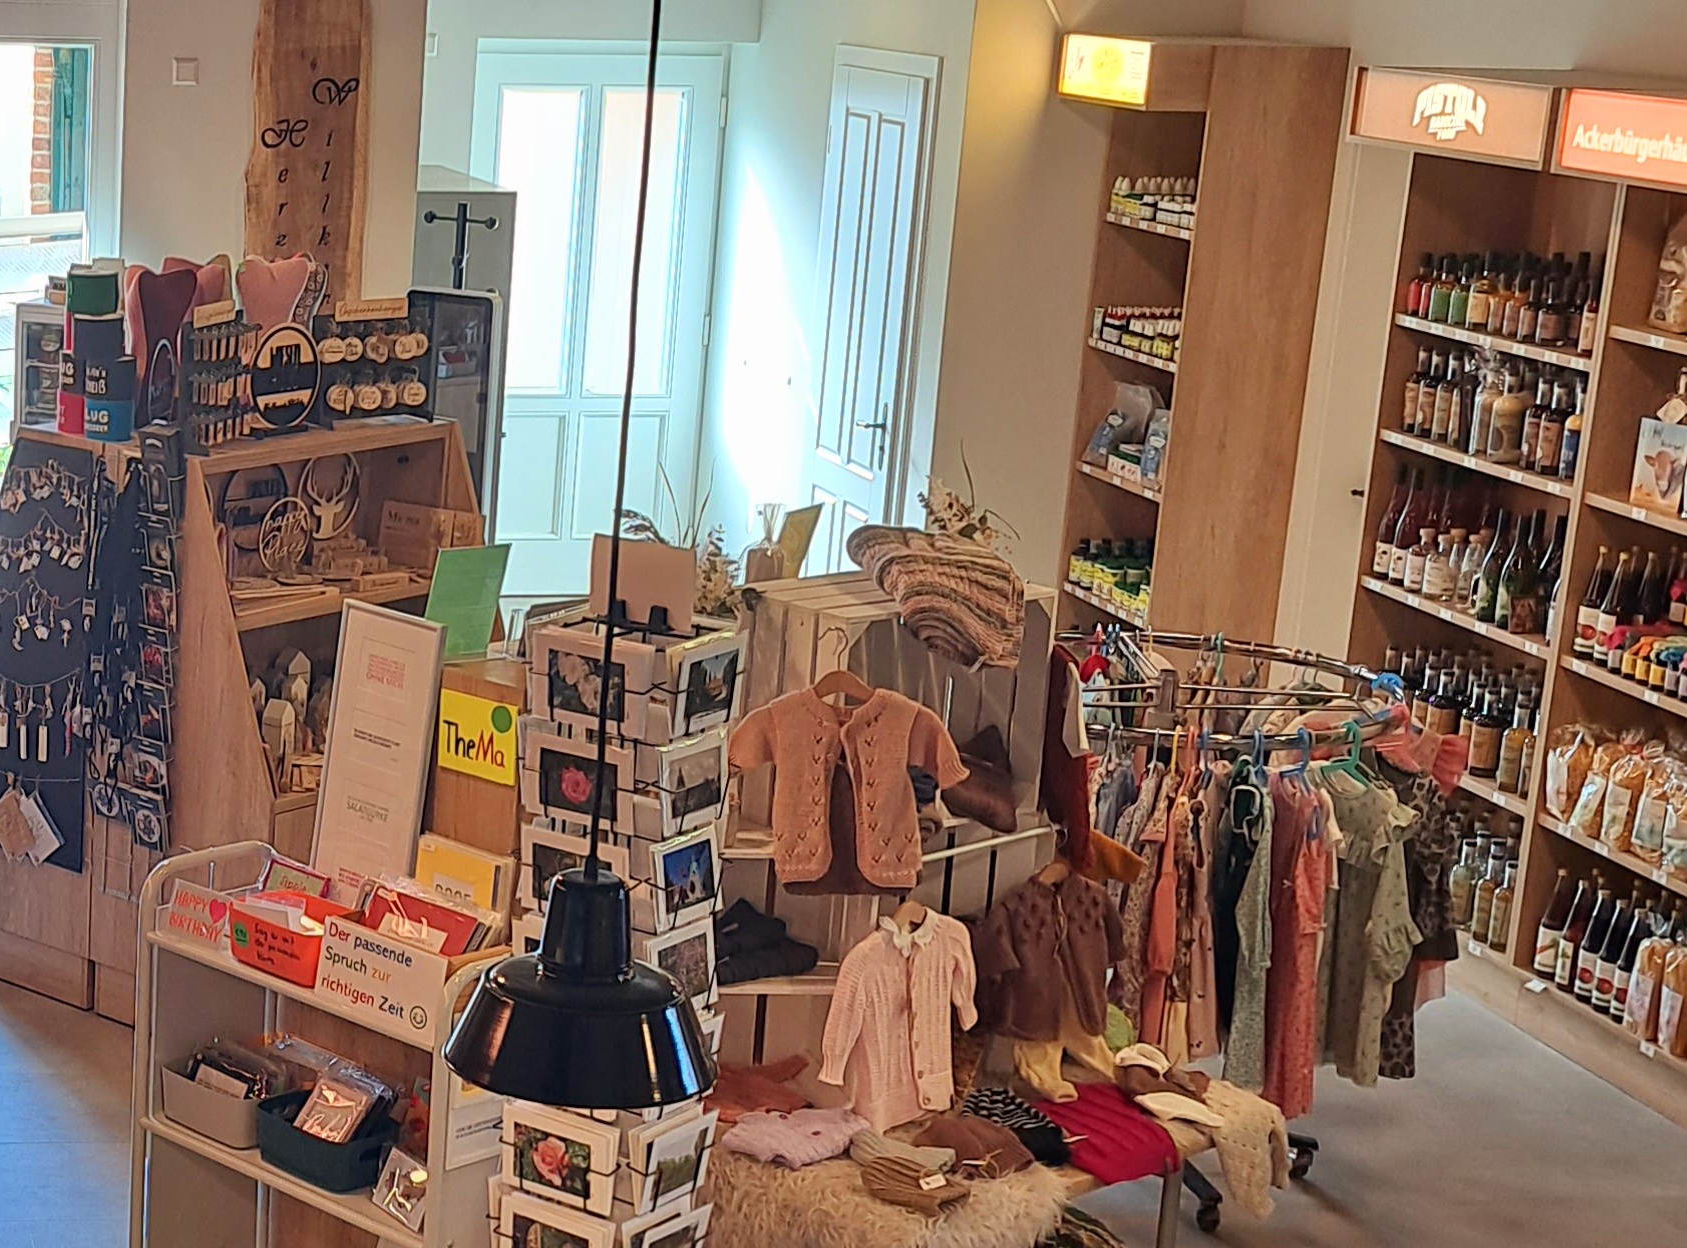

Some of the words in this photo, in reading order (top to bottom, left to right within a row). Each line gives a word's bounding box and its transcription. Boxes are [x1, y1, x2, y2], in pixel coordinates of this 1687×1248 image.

[85, 407, 109, 424] LUG
[443, 719, 506, 769] TheMa
[174, 889, 209, 913] HAPPY
[169, 910, 224, 943] BIRTHDAY
[328, 922, 349, 942] Der
[354, 932, 413, 967] passende
[325, 946, 367, 975] Spruch
[371, 966, 392, 984] zur
[321, 973, 375, 1008] richtigen
[378, 995, 404, 1019] Zeit
